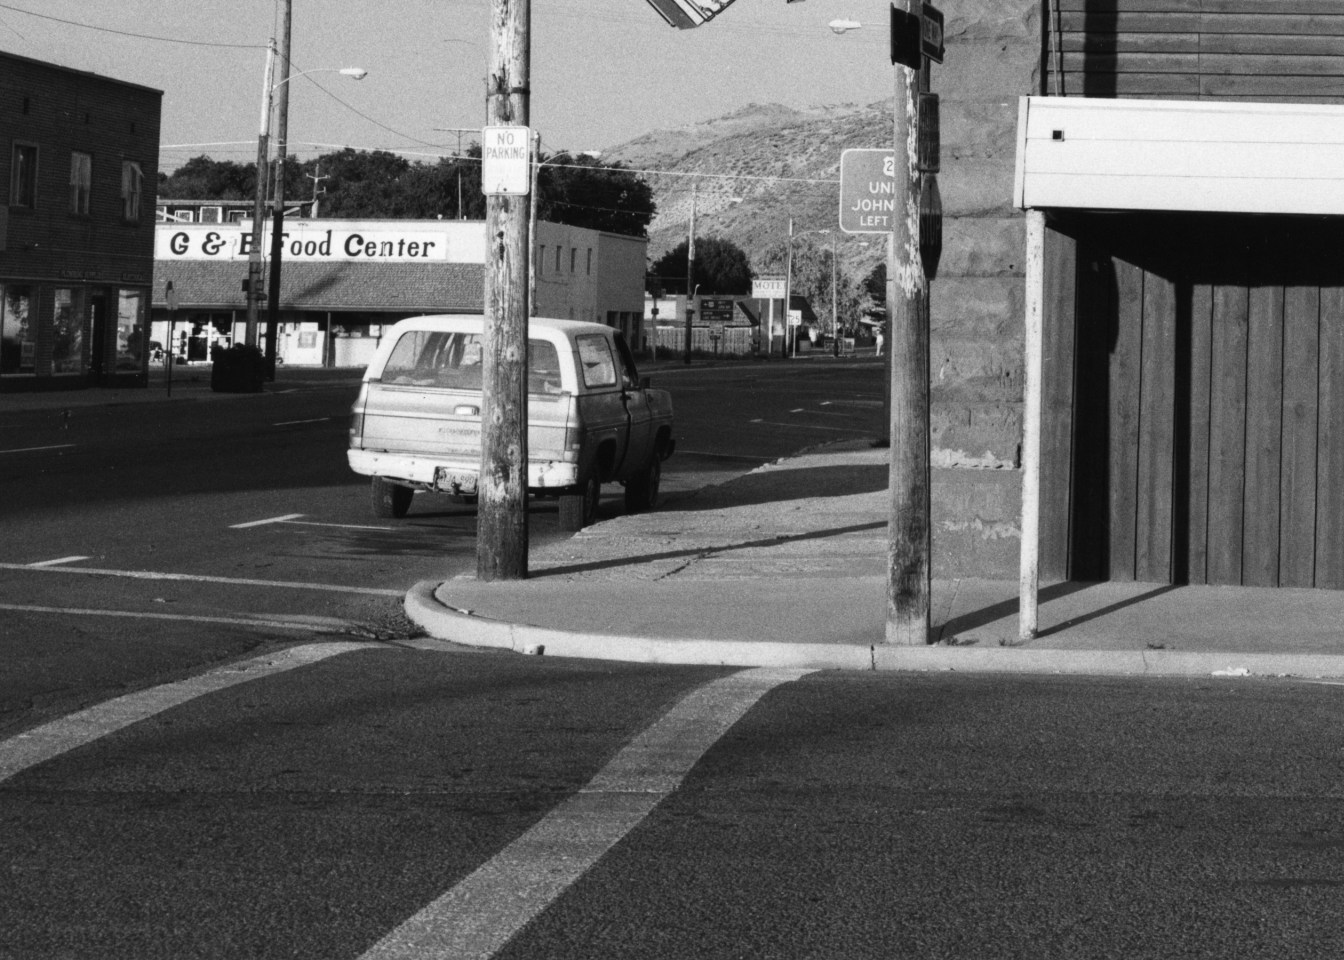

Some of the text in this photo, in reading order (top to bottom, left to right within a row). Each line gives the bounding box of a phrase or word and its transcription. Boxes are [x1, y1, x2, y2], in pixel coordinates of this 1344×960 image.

[497, 132, 514, 145] NO
[486, 147, 525, 160] PARKING
[860, 215, 889, 226] LEFT
[170, 232, 190, 256] G
[201, 232, 227, 256] &
[344, 233, 436, 257] Center
